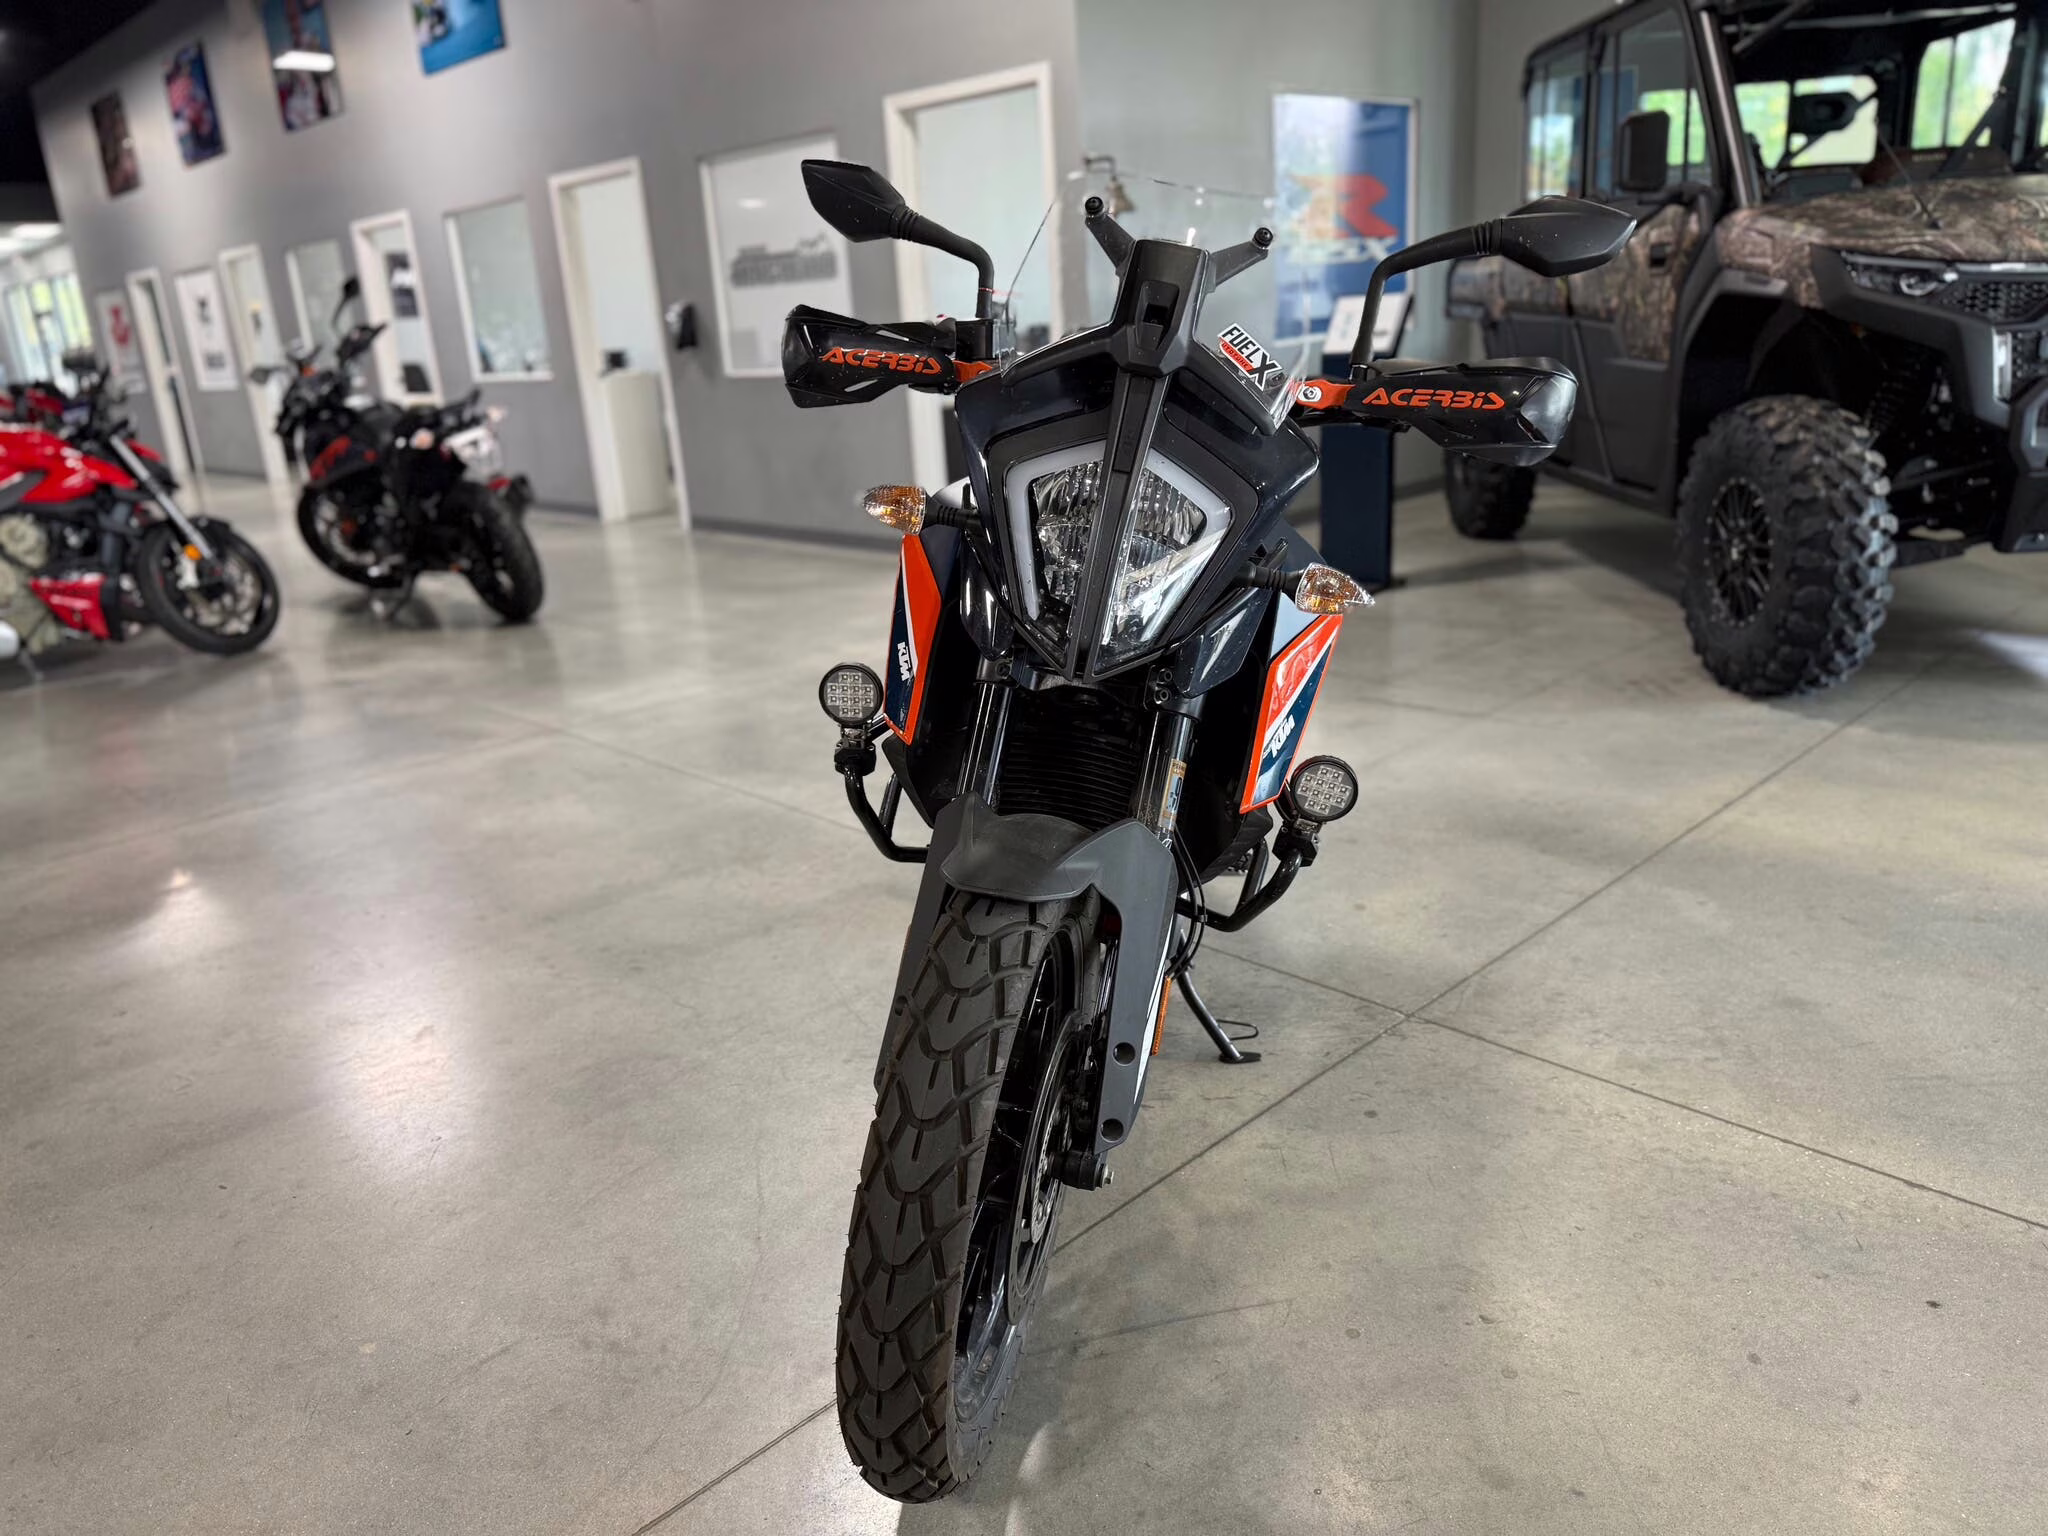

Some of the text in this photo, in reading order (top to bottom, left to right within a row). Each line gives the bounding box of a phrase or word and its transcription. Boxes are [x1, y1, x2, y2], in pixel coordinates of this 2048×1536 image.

[821, 346, 942, 374] ACERBIS
[1361, 387, 1505, 410] ACERBIS
[897, 641, 912, 681] KTM
[1263, 714, 1296, 759] KTM
